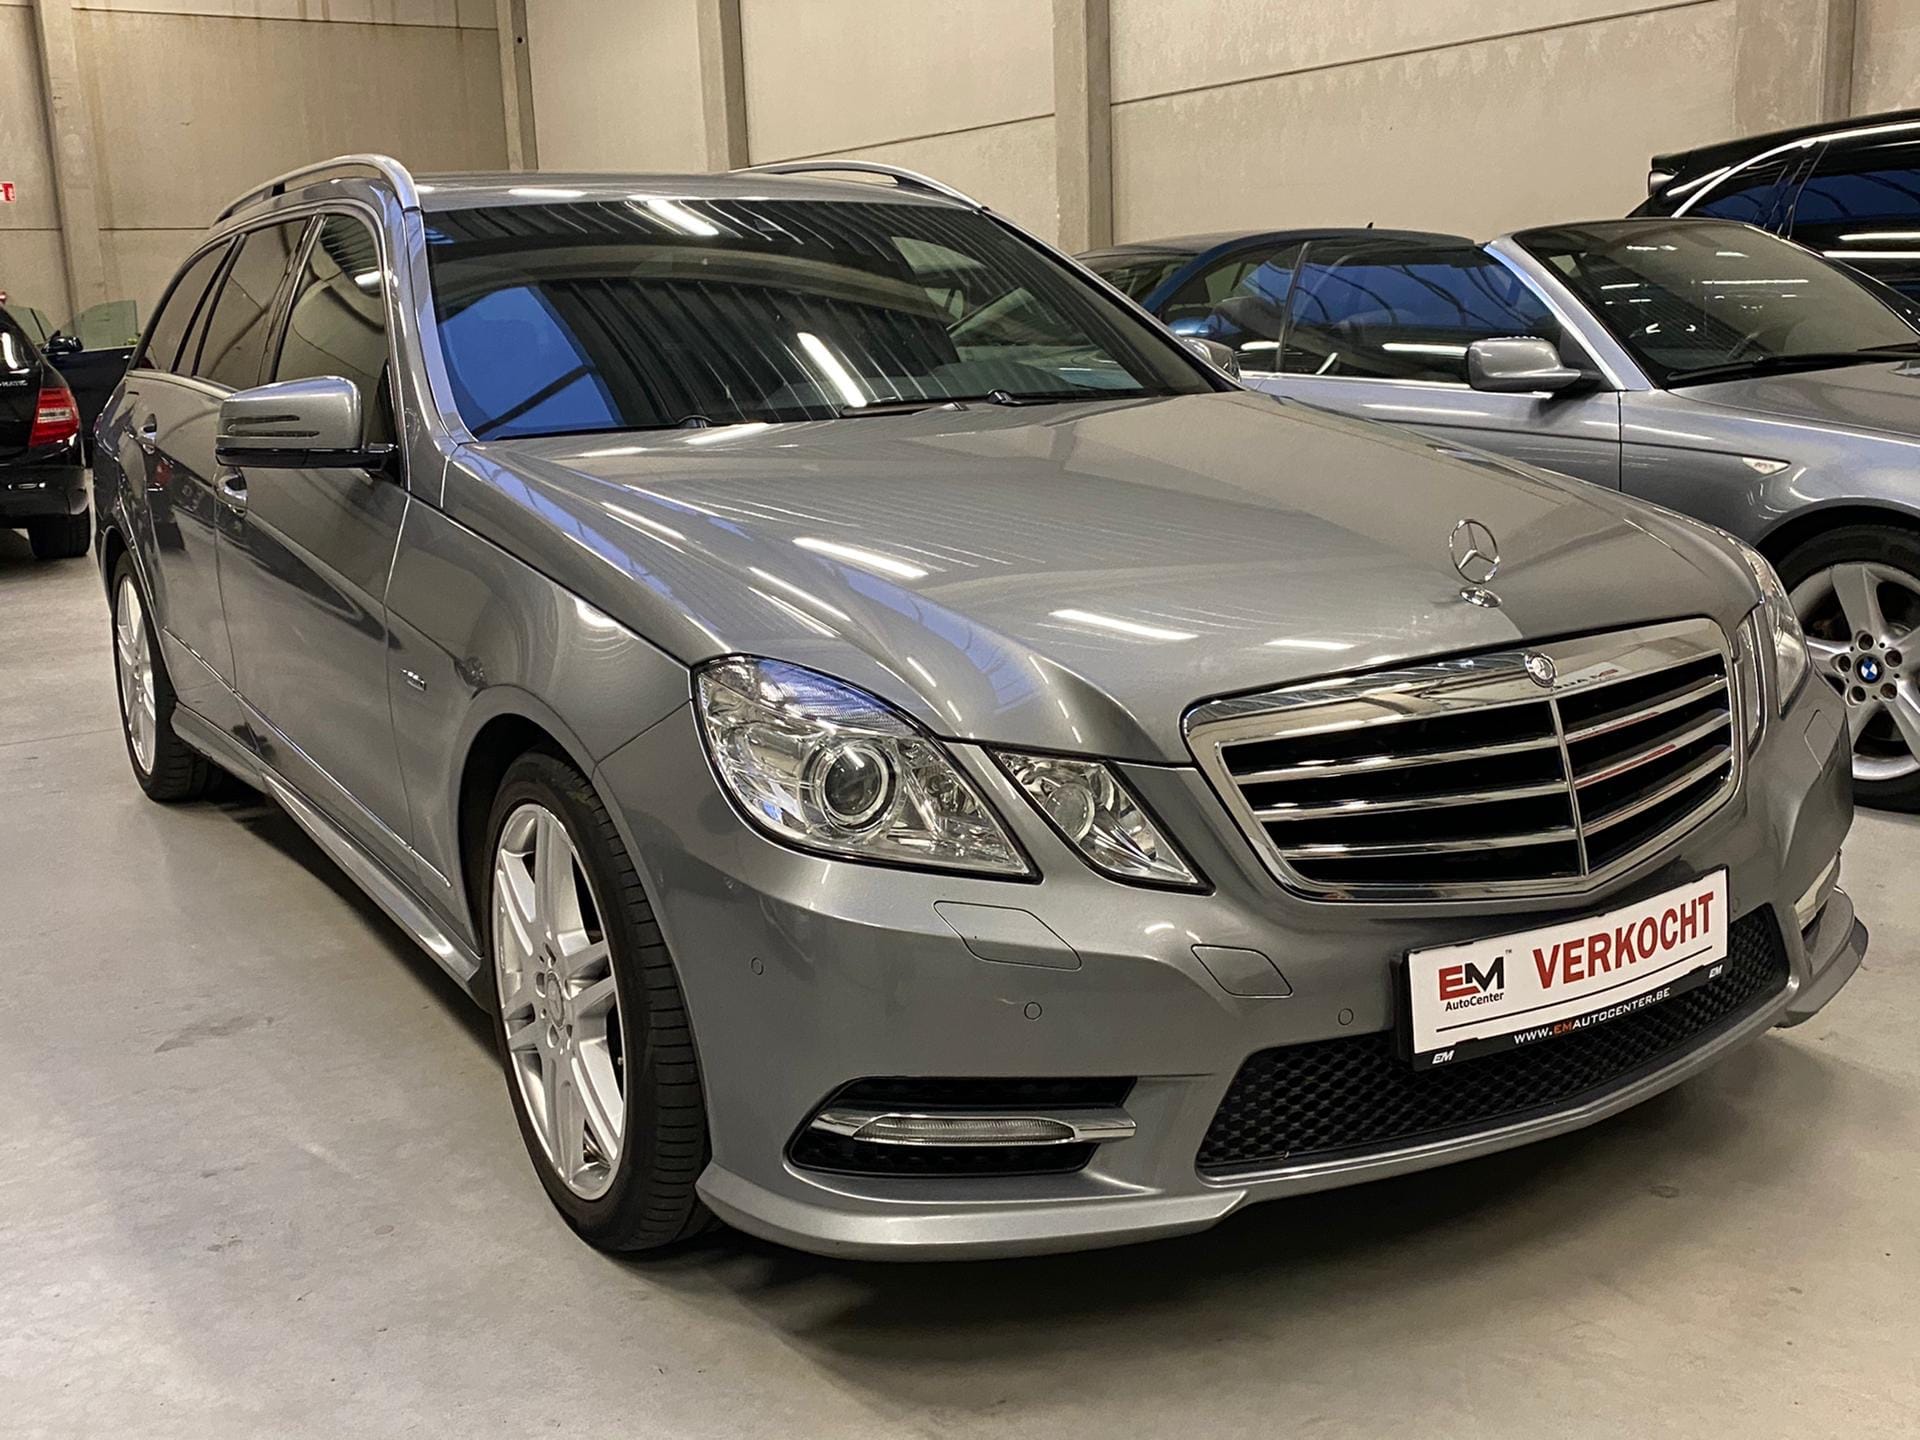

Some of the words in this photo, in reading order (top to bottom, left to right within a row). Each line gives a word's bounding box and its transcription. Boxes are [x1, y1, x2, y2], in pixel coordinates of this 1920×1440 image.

[1532, 891, 1714, 990] VERKOCHT
[1439, 956, 1504, 1001] EM
[1445, 992, 1504, 1012] AutoCenter
[1513, 987, 1671, 1045] WWW.EMAUTOCENTER.BE
[1432, 1050, 1454, 1064] EM
